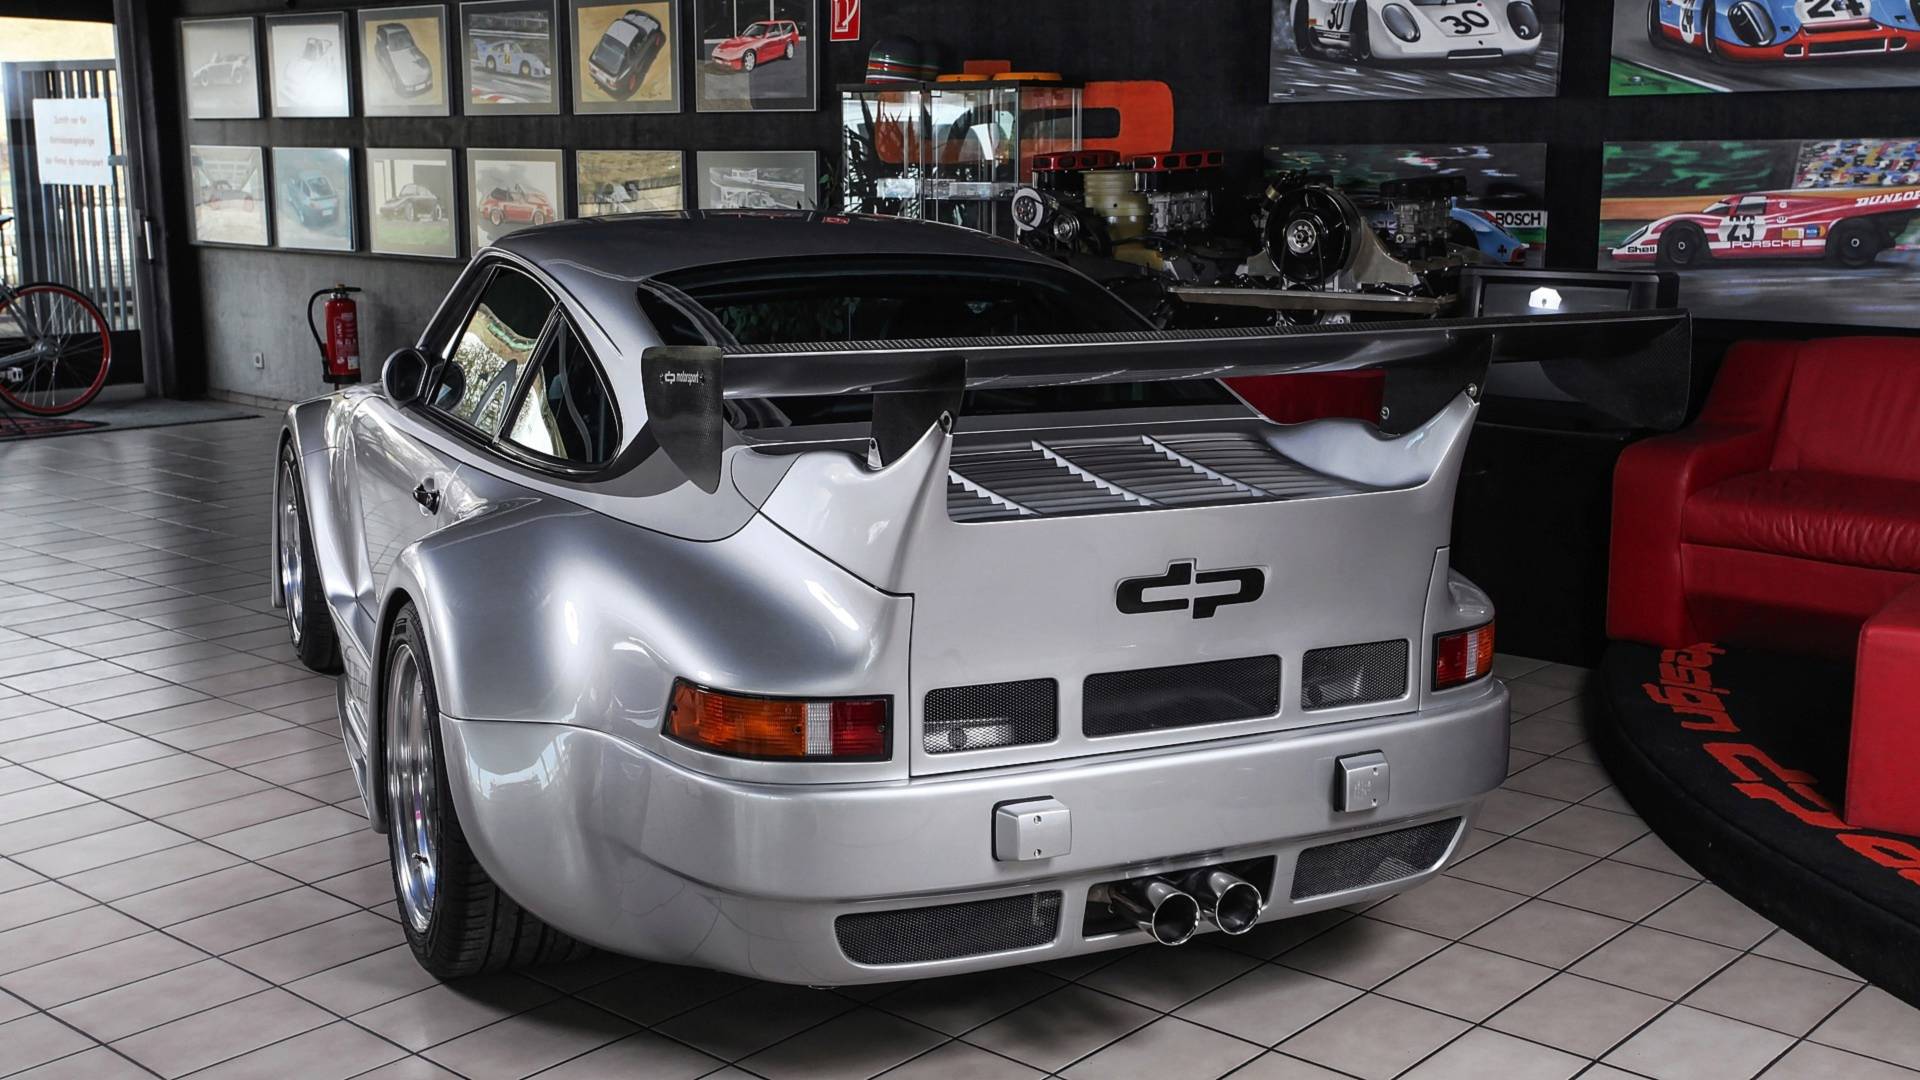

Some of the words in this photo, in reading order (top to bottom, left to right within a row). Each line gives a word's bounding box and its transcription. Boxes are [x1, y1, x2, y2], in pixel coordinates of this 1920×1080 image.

[1804, 0, 1865, 18] 24
[1440, 10, 1490, 34] 30
[1495, 211, 1541, 226] BOSCH
[1727, 214, 1755, 241] 23
[1732, 240, 1801, 249] PORSCHE
[677, 370, 699, 386] motorsport
[1116, 562, 1266, 620] dp
